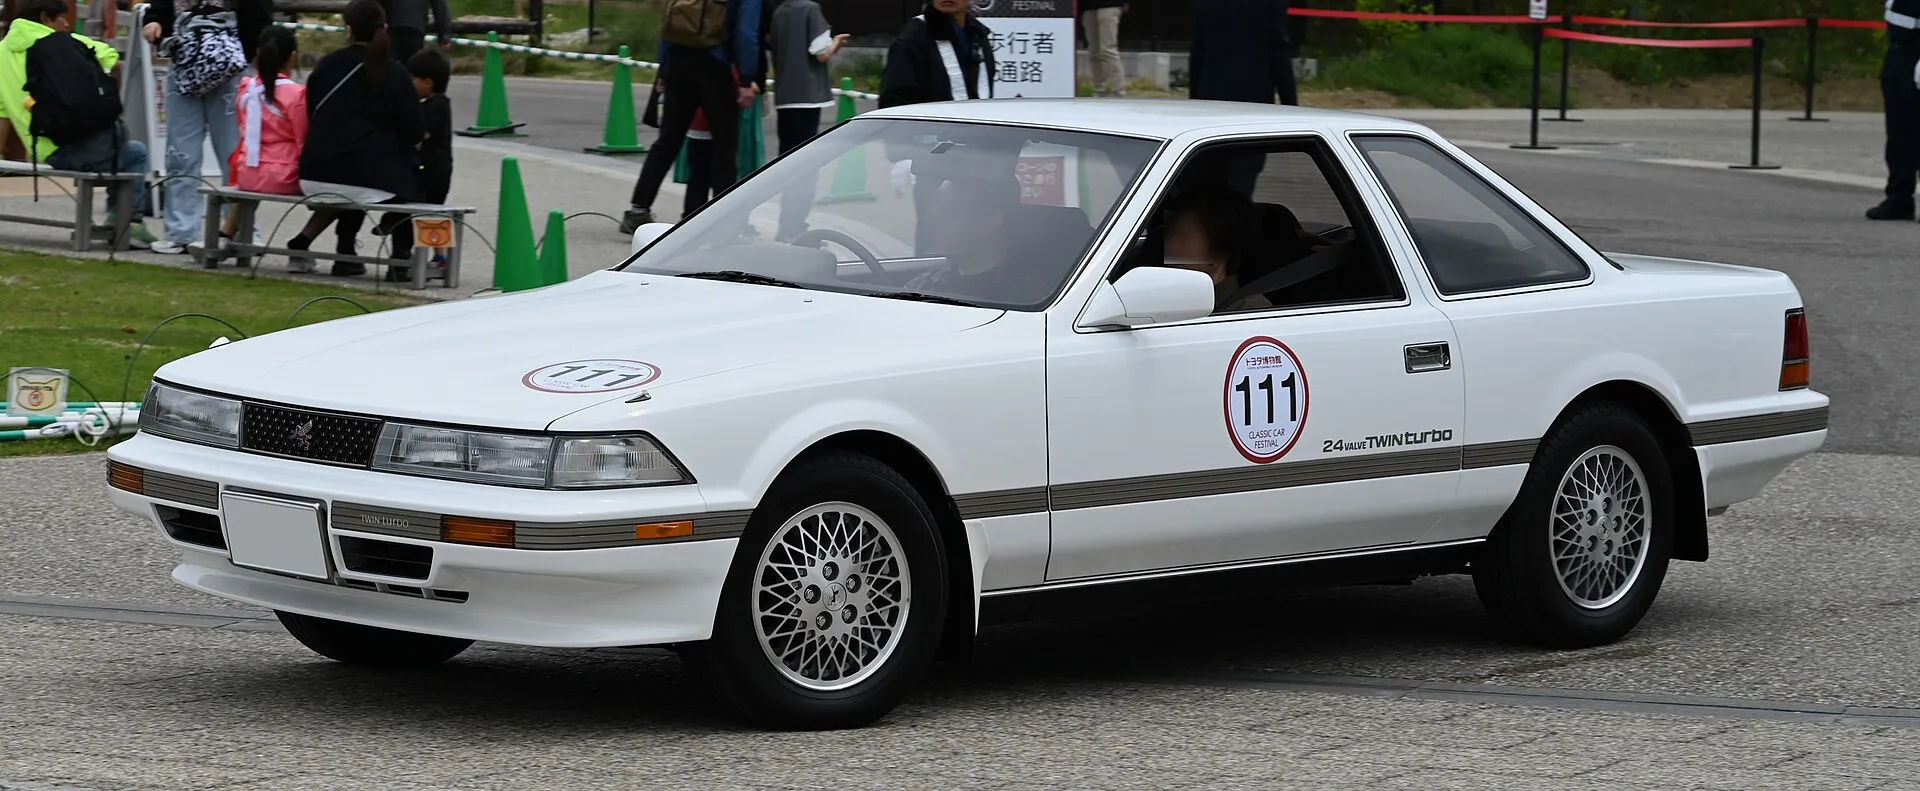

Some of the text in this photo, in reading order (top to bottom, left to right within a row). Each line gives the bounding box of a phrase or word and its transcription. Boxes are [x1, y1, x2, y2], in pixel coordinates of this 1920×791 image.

[994, 60, 1043, 83] 通路
[1245, 355, 1282, 367] トヨタ博物館
[549, 365, 643, 387] 111
[1235, 372, 1297, 426] 111
[1248, 428, 1286, 440] CLASSIC CAR
[1365, 434, 1403, 449] TWIN
[1404, 429, 1453, 445] turbo
[1254, 439, 1279, 449] FESTIVAL
[360, 514, 409, 528] TWIN turbo
